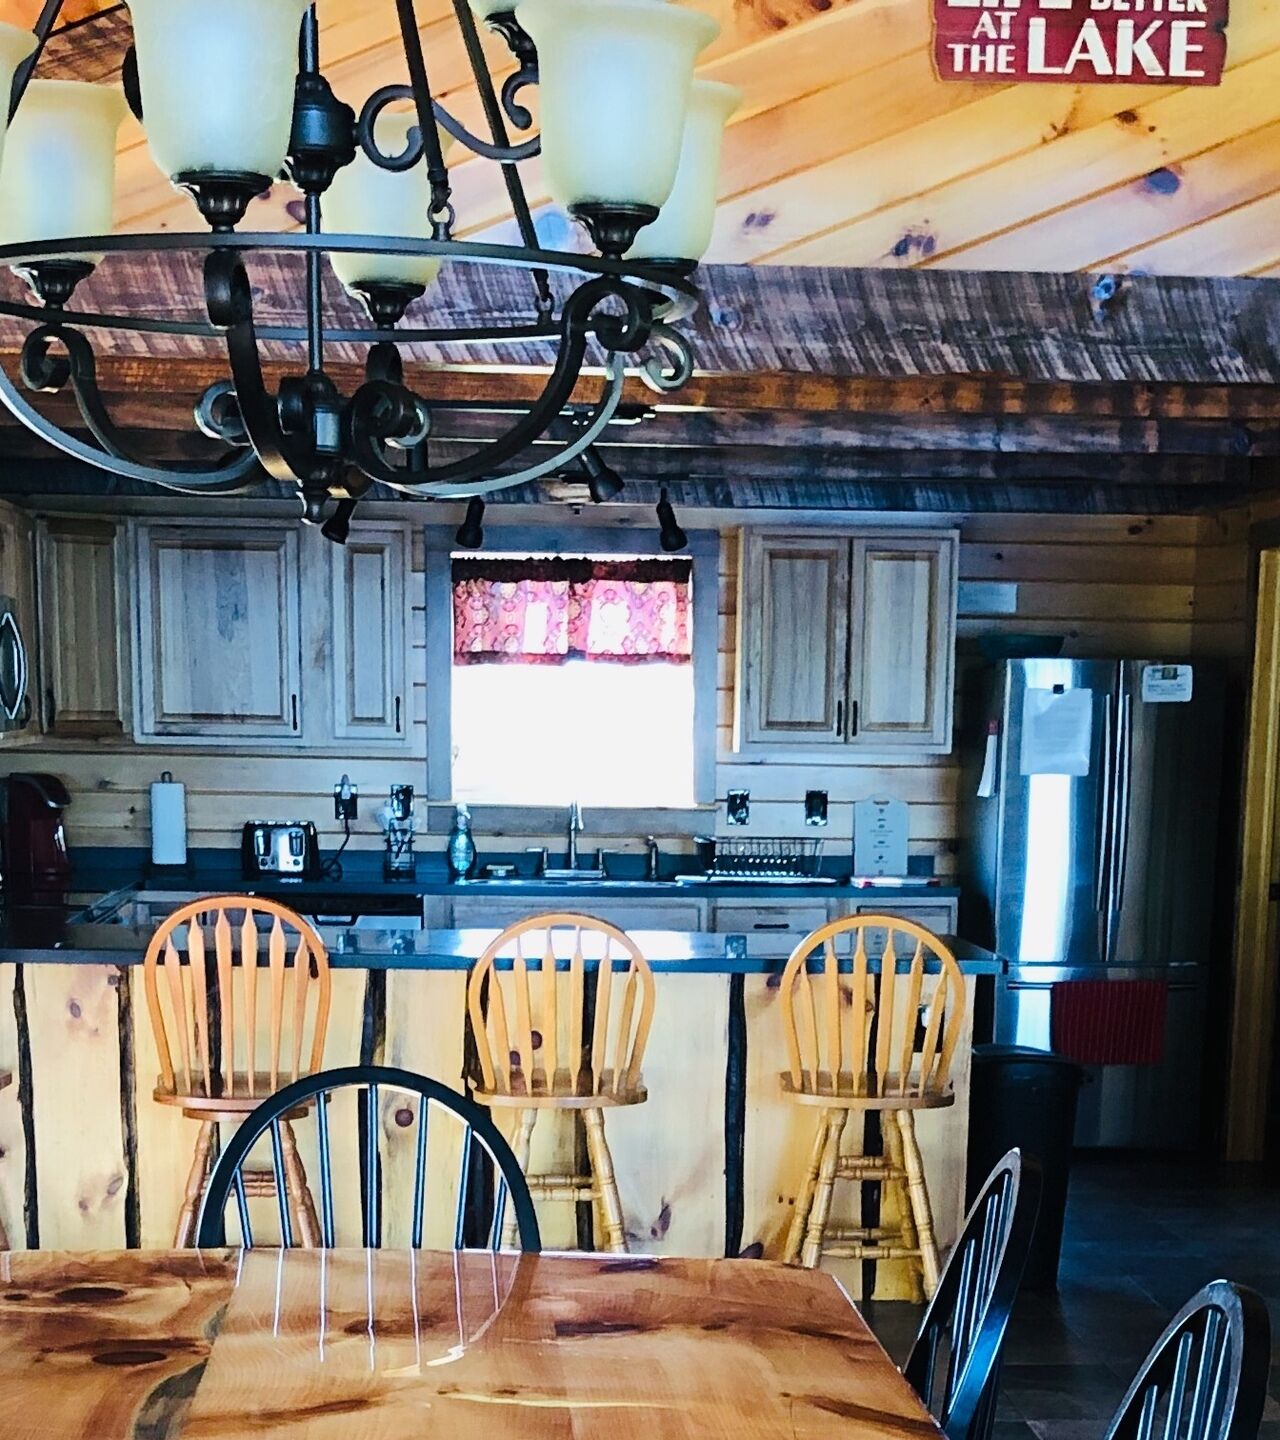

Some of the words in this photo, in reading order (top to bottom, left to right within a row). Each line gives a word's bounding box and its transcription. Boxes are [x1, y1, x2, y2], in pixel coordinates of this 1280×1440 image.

[947, 43, 1016, 74] THE
[1027, 17, 1205, 77] LAKE
[972, 11, 1017, 39] AT
